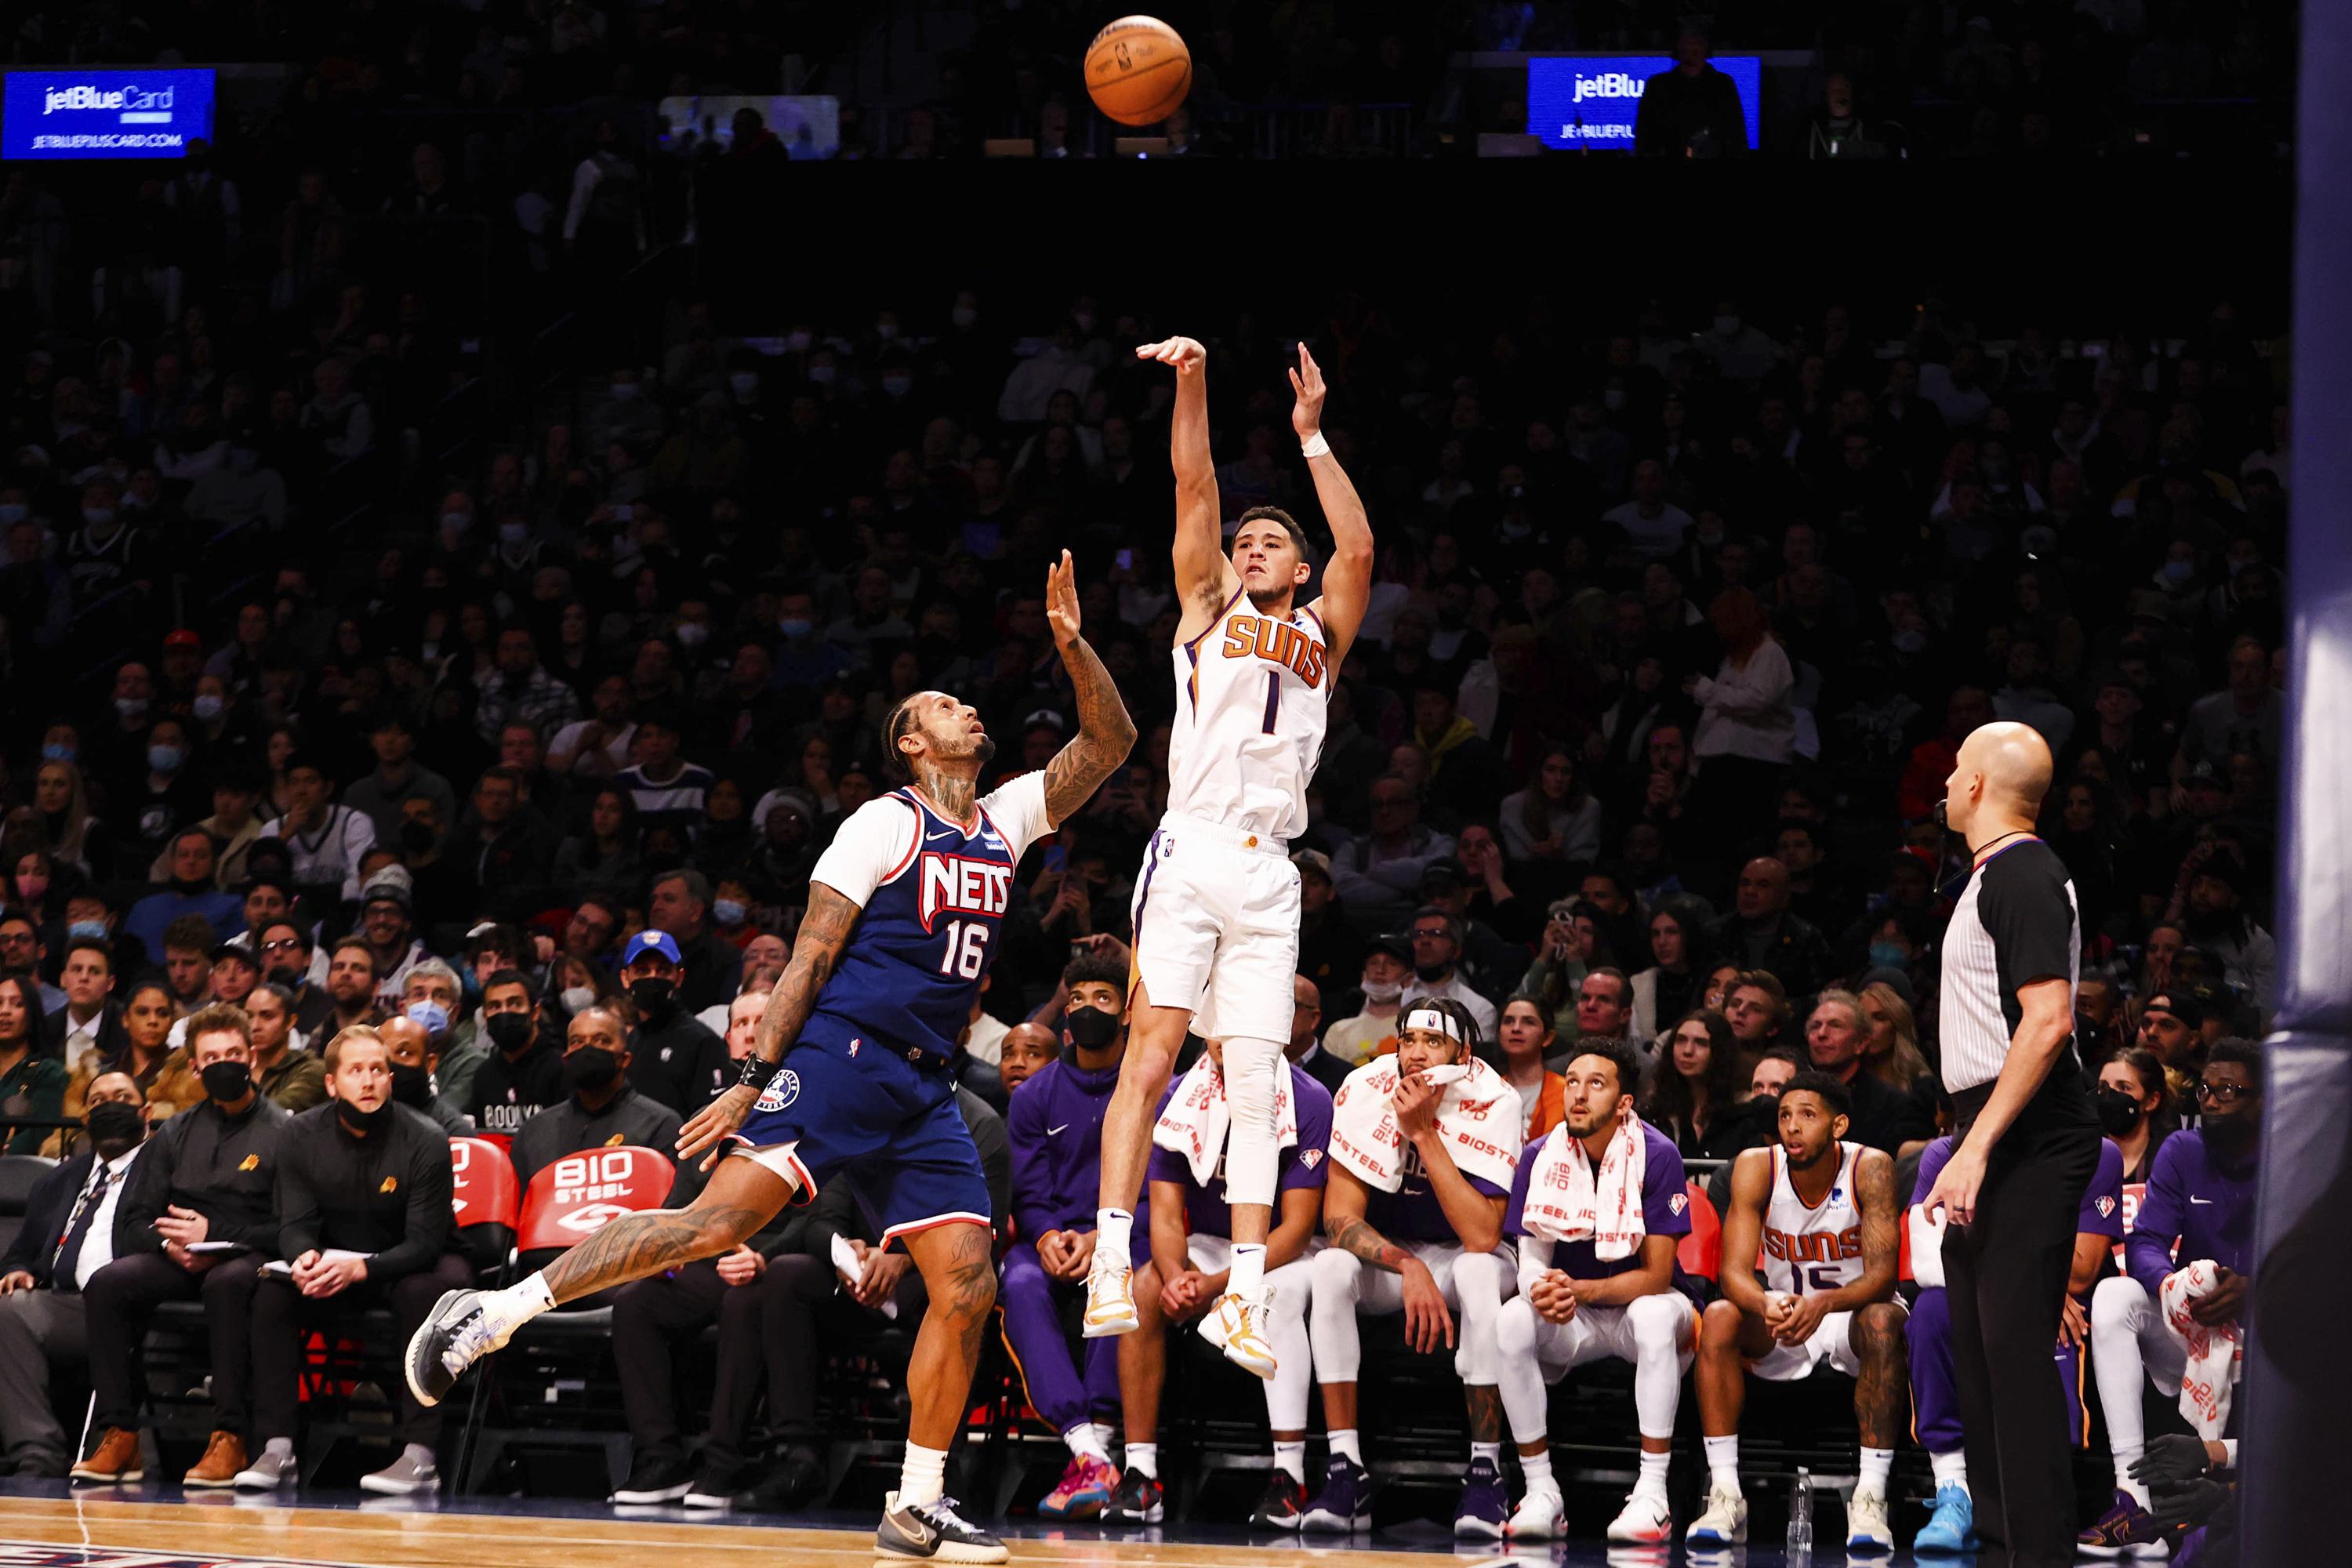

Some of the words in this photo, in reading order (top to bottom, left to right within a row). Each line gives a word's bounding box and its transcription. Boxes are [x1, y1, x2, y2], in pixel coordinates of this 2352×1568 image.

[1572, 73, 1646, 103] jetBlu
[1222, 615, 1326, 690] SUNS
[1261, 670, 1280, 735] 1
[919, 851, 1013, 935] NETS
[940, 920, 989, 980] 16
[554, 1151, 633, 1189] BIO
[554, 1182, 633, 1203] STEEL
[1762, 1224, 1864, 1263] SUNS
